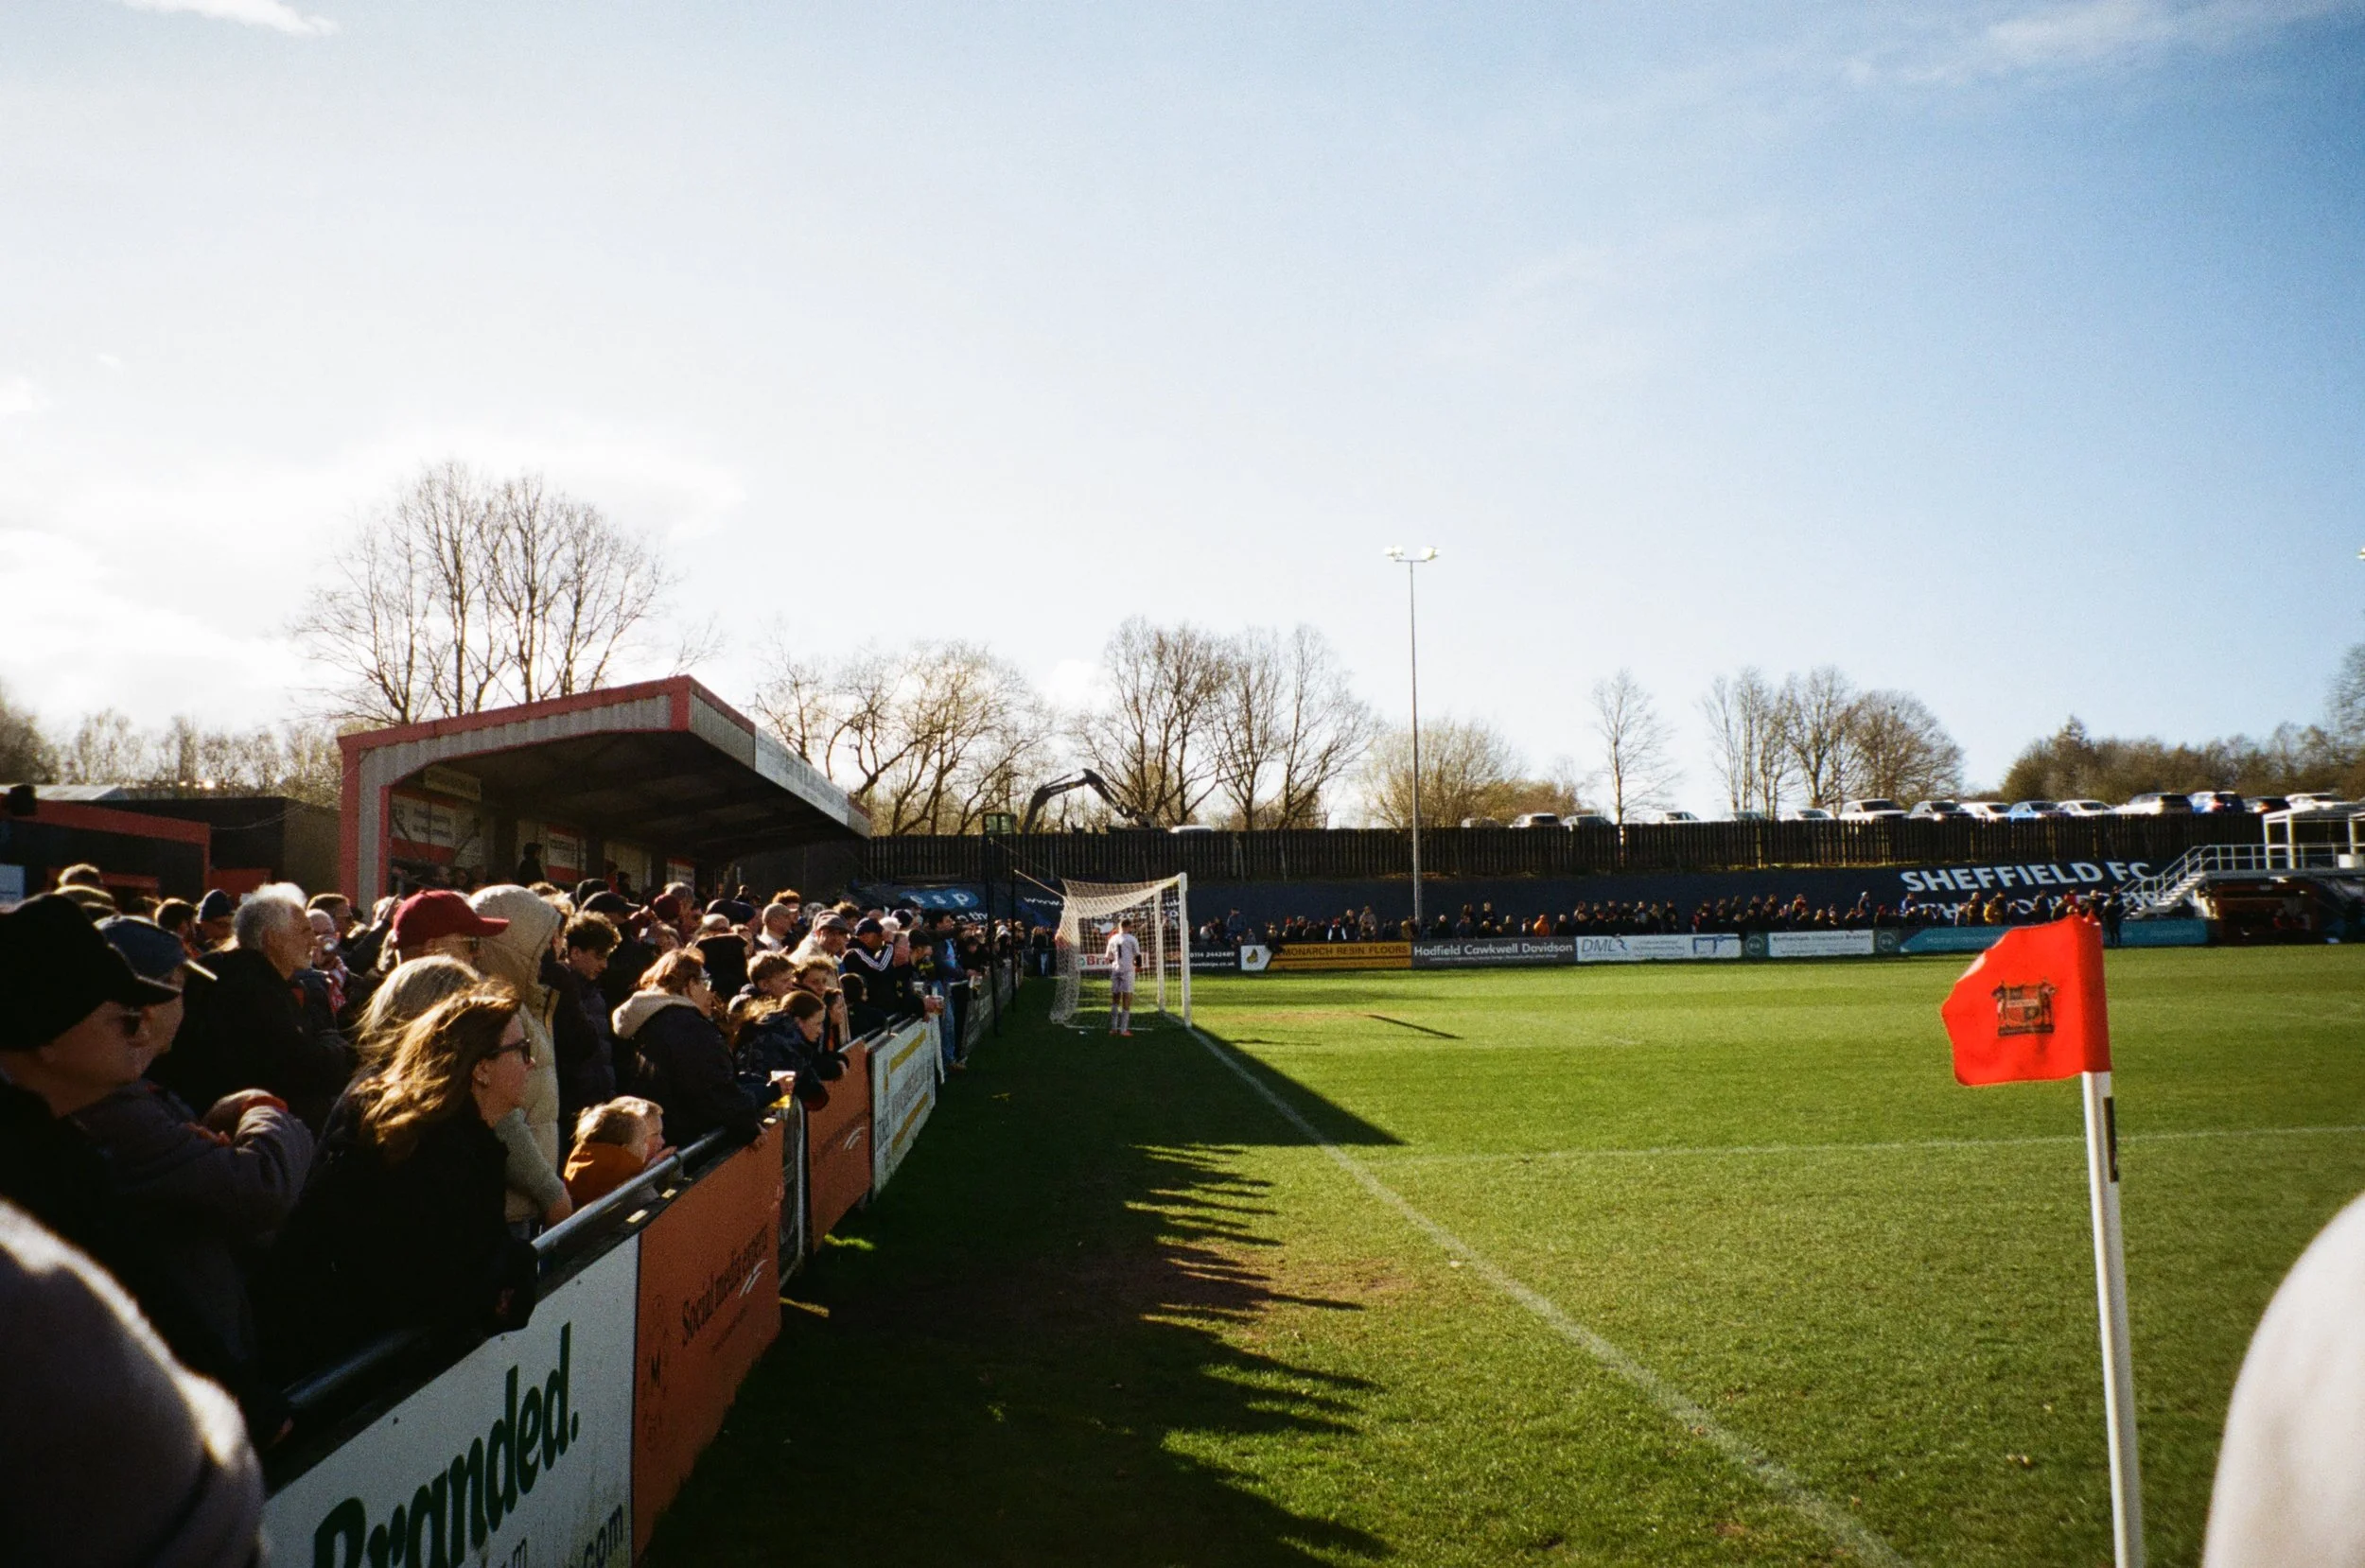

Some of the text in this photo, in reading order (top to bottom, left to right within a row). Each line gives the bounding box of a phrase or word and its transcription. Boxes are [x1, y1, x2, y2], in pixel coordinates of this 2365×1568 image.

[1900, 862, 2154, 892] SHEFFIELD FC
[1283, 944, 1408, 956] MONARCH RESIN FLOORS
[1413, 943, 1573, 956] Hadfield Cawkwell Davidson
